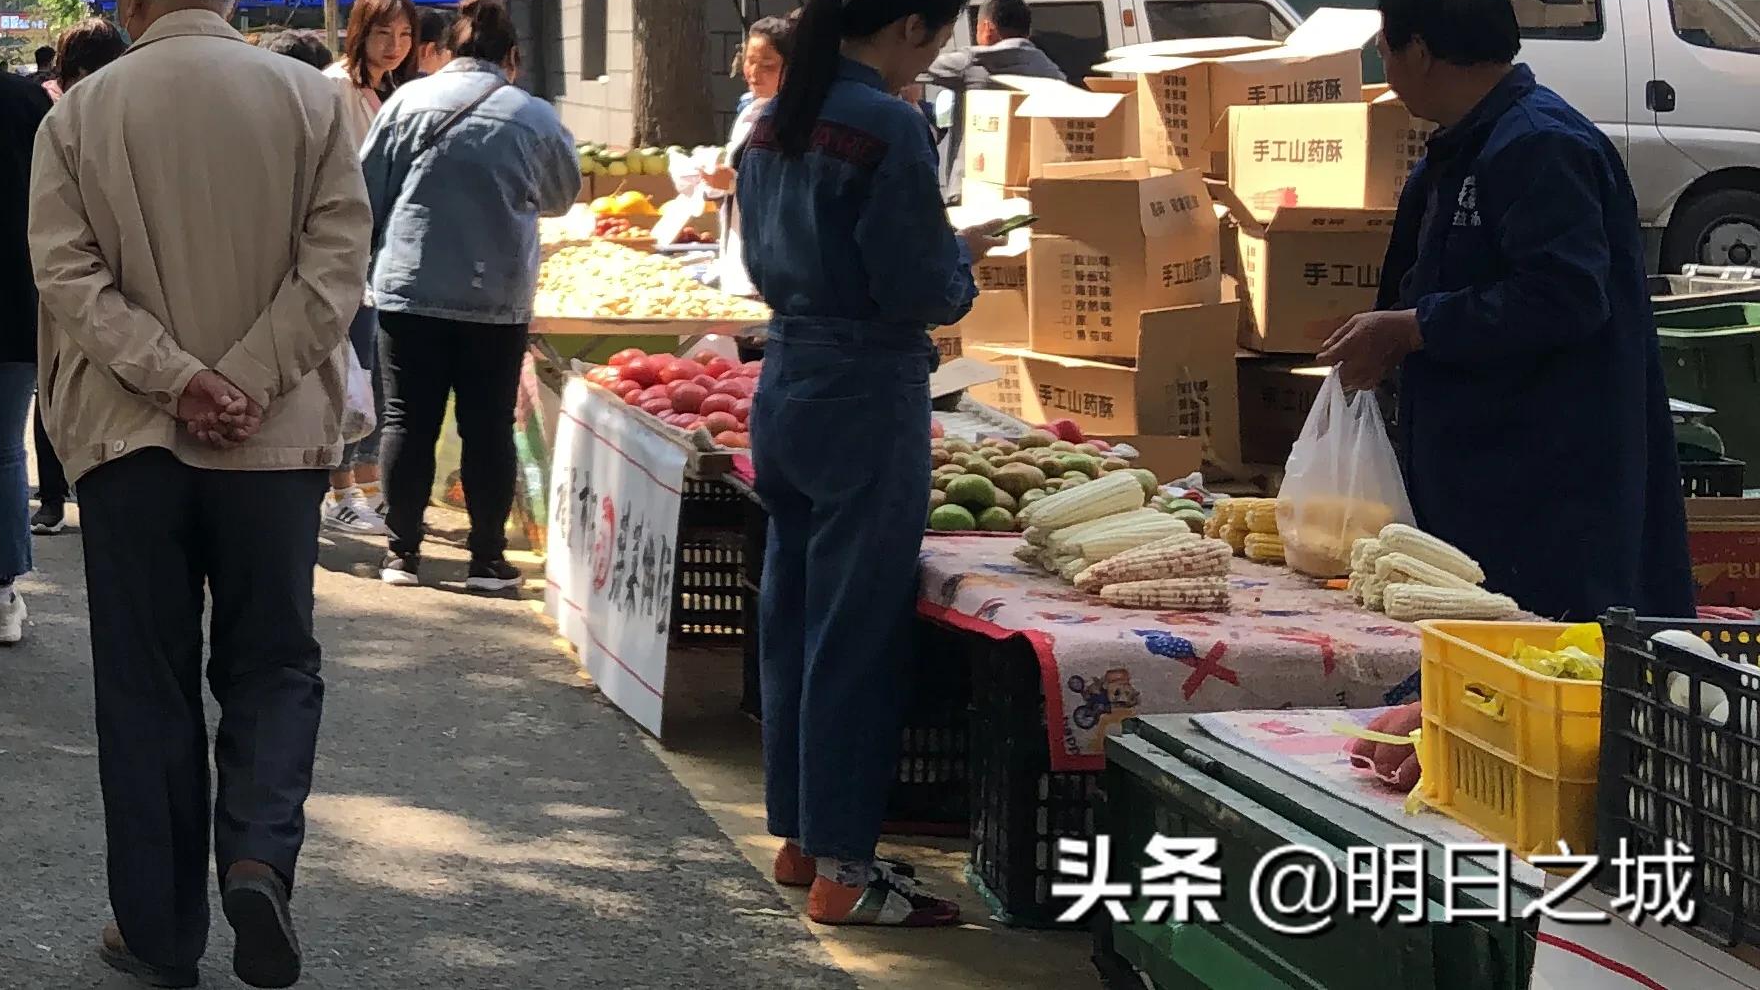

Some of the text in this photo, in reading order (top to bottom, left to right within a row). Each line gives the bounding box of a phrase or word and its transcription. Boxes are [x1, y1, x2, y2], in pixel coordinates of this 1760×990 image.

[1248, 78, 1342, 105] 手工山药酥
[1253, 139, 1343, 164] 手工山药酥
[1039, 383, 1114, 419] 手工山药酥
